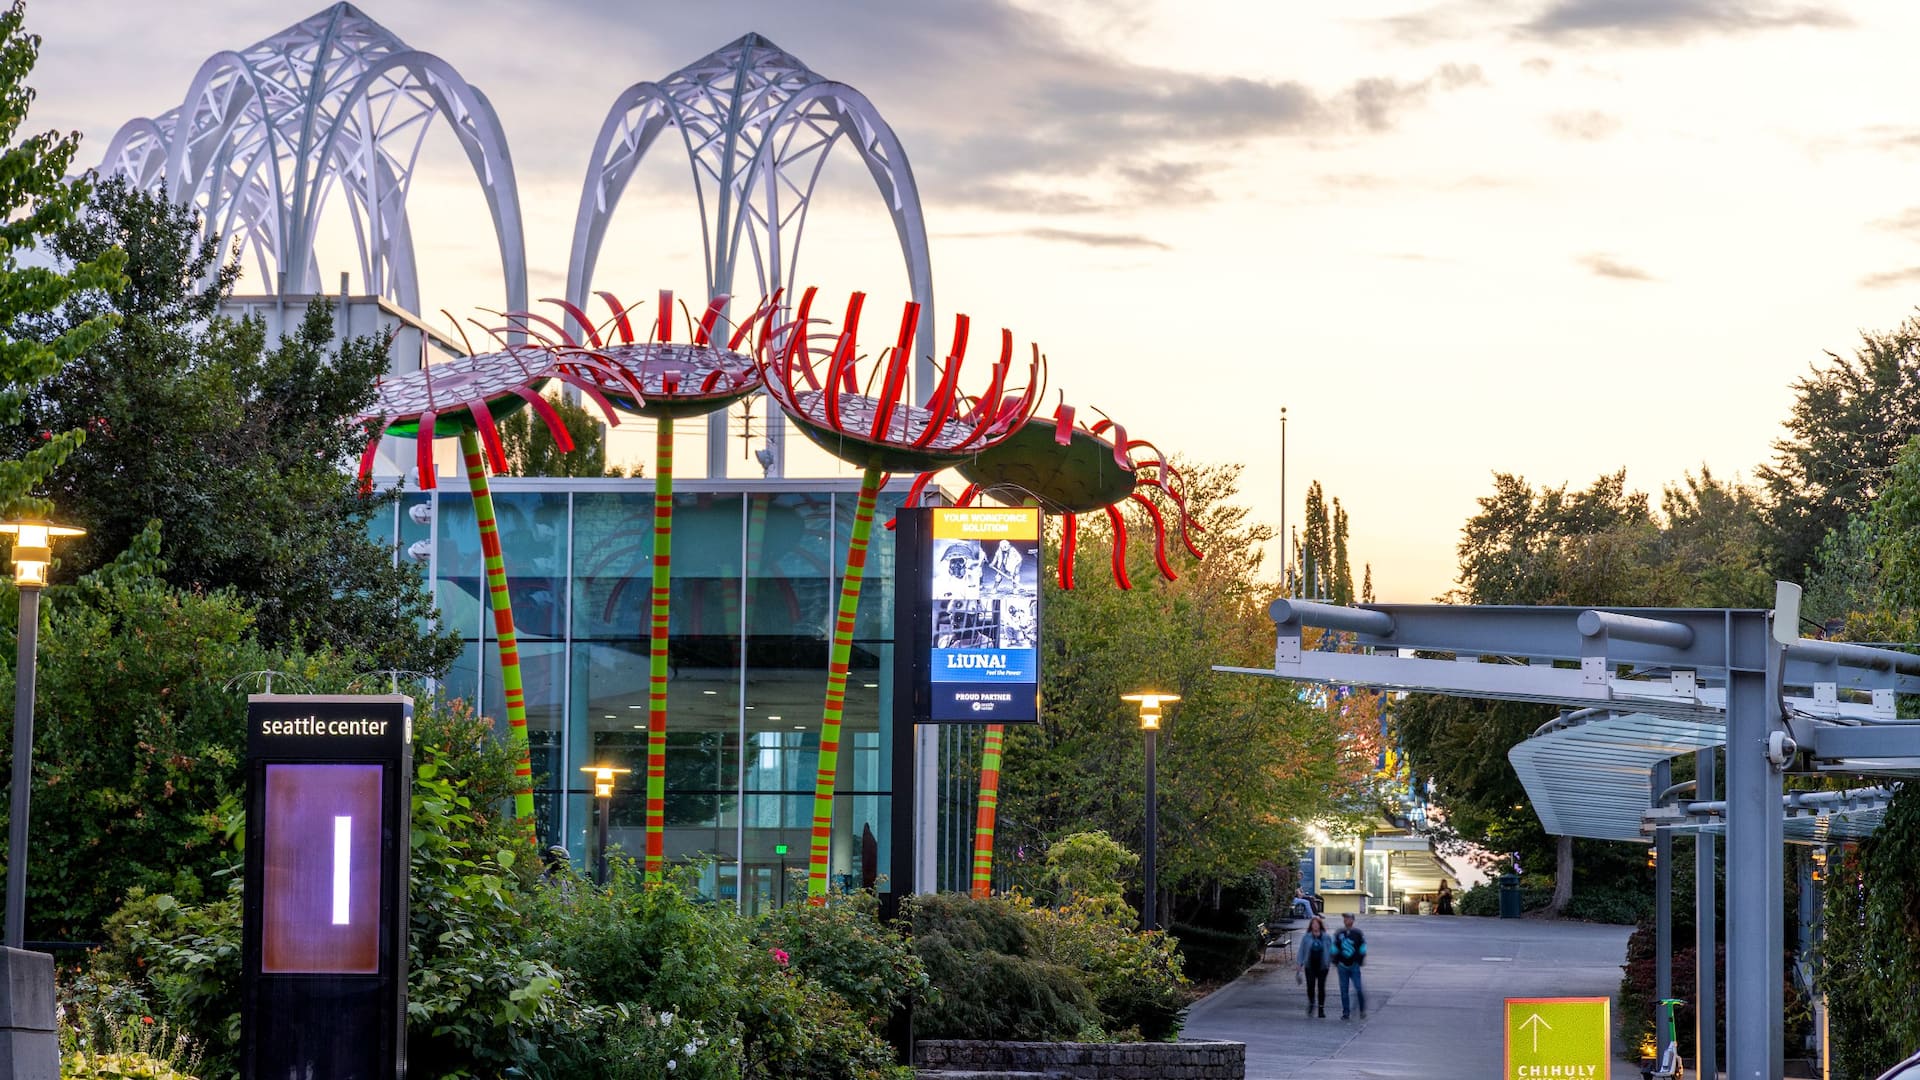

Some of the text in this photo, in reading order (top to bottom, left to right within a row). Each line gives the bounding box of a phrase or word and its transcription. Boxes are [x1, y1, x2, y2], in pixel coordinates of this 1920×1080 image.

[943, 513, 1027, 522] YOUR WORKFORCE
[962, 523, 1008, 532] SOLUTION
[955, 693, 1011, 701] PROUD PARTNER
[262, 716, 388, 735] seattle center
[1517, 1065, 1596, 1076] CHIHULY
